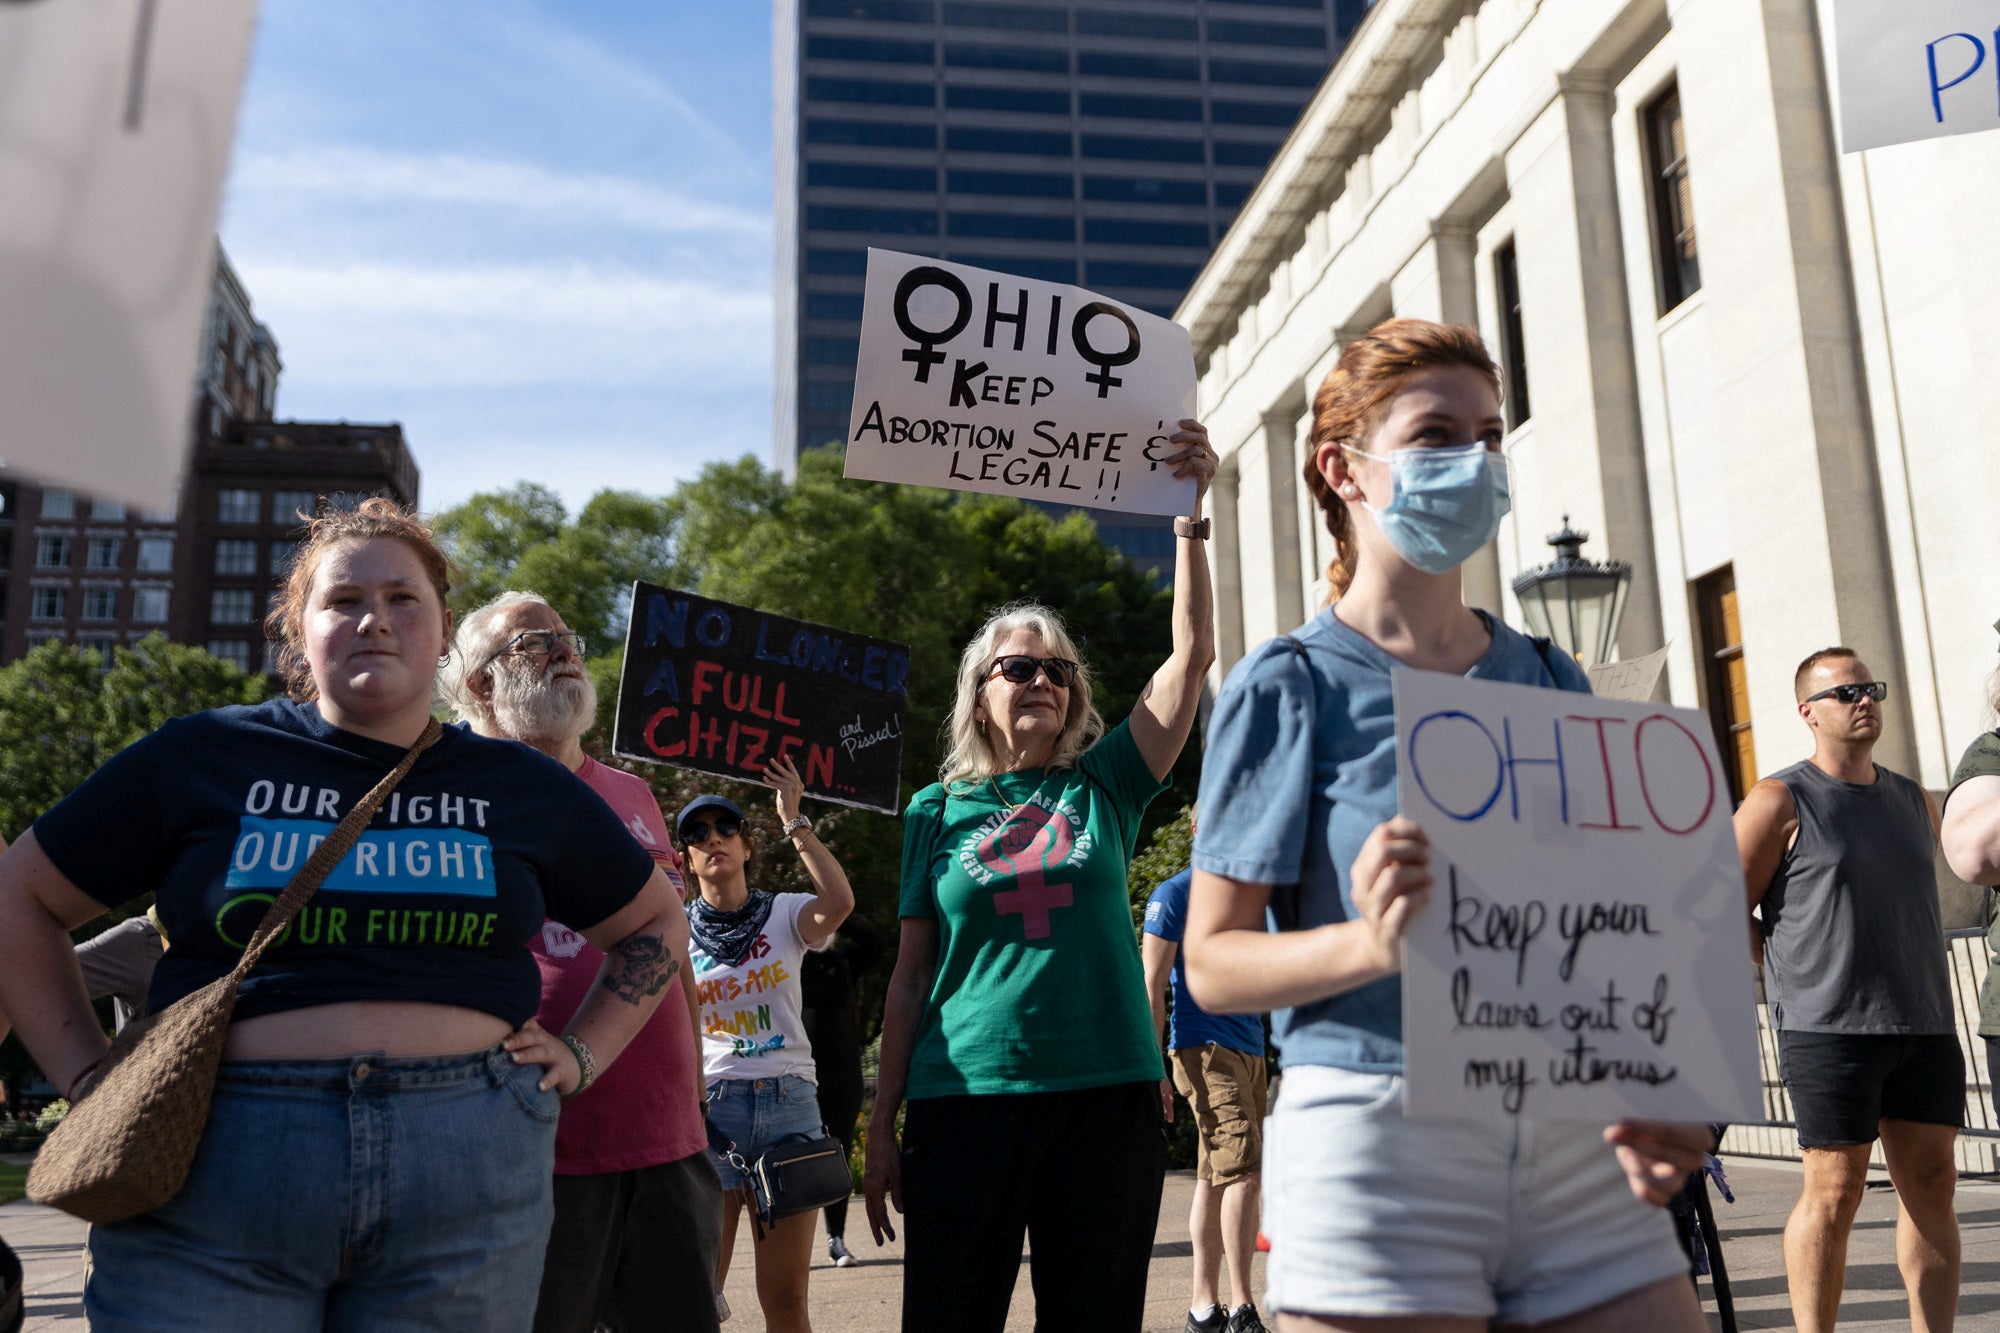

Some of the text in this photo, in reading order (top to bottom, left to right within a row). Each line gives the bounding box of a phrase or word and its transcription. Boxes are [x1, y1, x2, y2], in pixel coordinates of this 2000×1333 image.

[1926, 24, 2000, 122] P
[894, 266, 1141, 398] OHIO
[949, 359, 1054, 409] KEEP
[854, 401, 1014, 450] ABORTION
[1028, 421, 1128, 462] SAFE
[644, 593, 911, 697] NO LONGER
[642, 658, 800, 727] A FULL
[839, 714, 864, 738] and
[1409, 710, 1715, 835] OHIO
[245, 779, 490, 828] OUR IGHT
[961, 808, 1014, 852] AORTIO
[356, 841, 487, 880] RIGHT
[960, 851, 994, 886] KEEP
[215, 893, 498, 949] OUR FUTURE
[1447, 863, 1661, 986] keep your
[744, 960, 790, 995] ARE
[1451, 966, 1677, 1045] laws out of
[1464, 1037, 1678, 1113] my uterus
